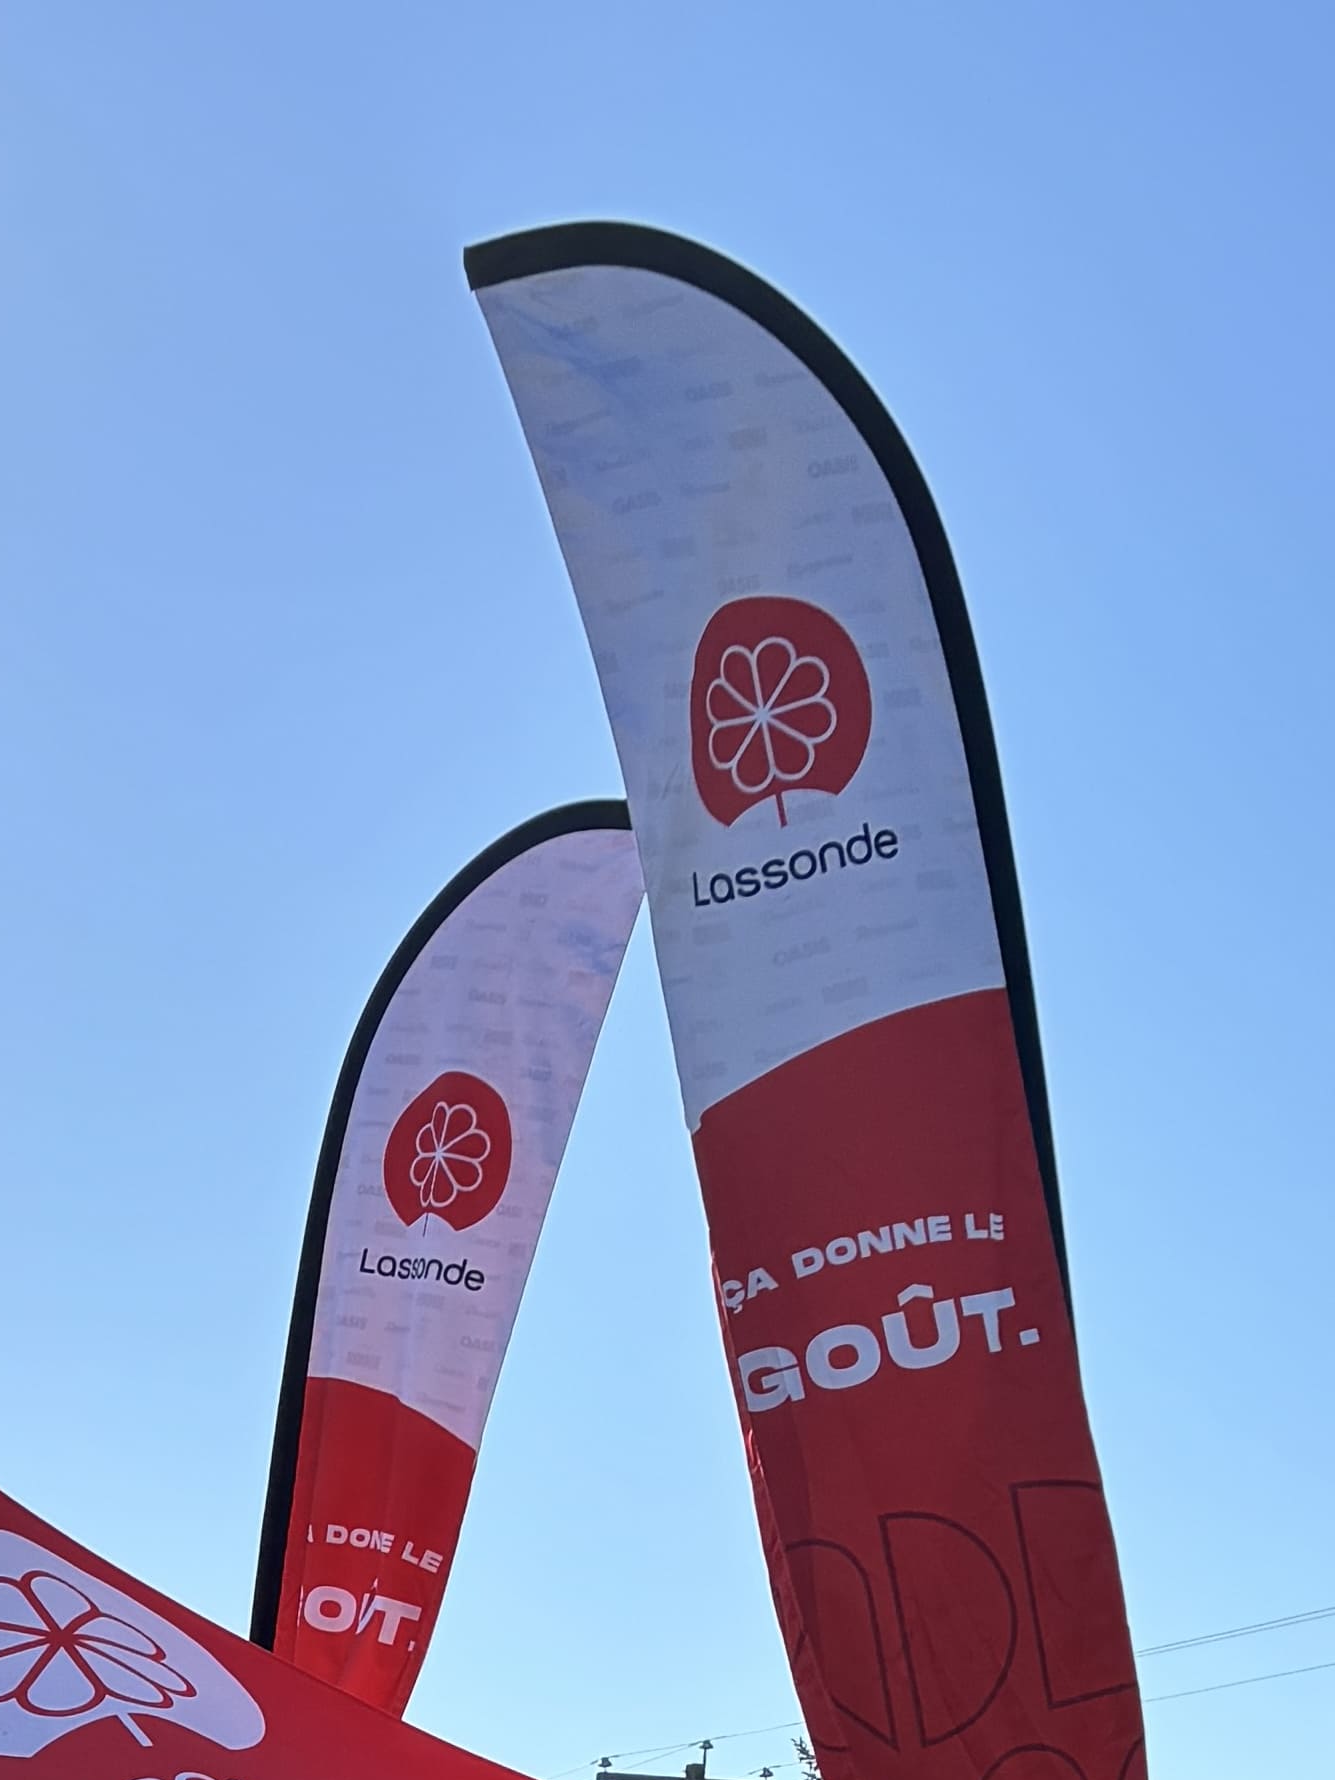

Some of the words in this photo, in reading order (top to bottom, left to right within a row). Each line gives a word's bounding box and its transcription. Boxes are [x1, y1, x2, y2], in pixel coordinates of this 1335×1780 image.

[692, 822, 900, 907] Lassonde
[721, 1267, 779, 1314] ÇA
[791, 1214, 953, 1280] DONNE
[964, 1212, 1005, 1241] LE
[737, 1283, 1041, 1413] GOÛT.
[400, 1540, 444, 1574] LE
